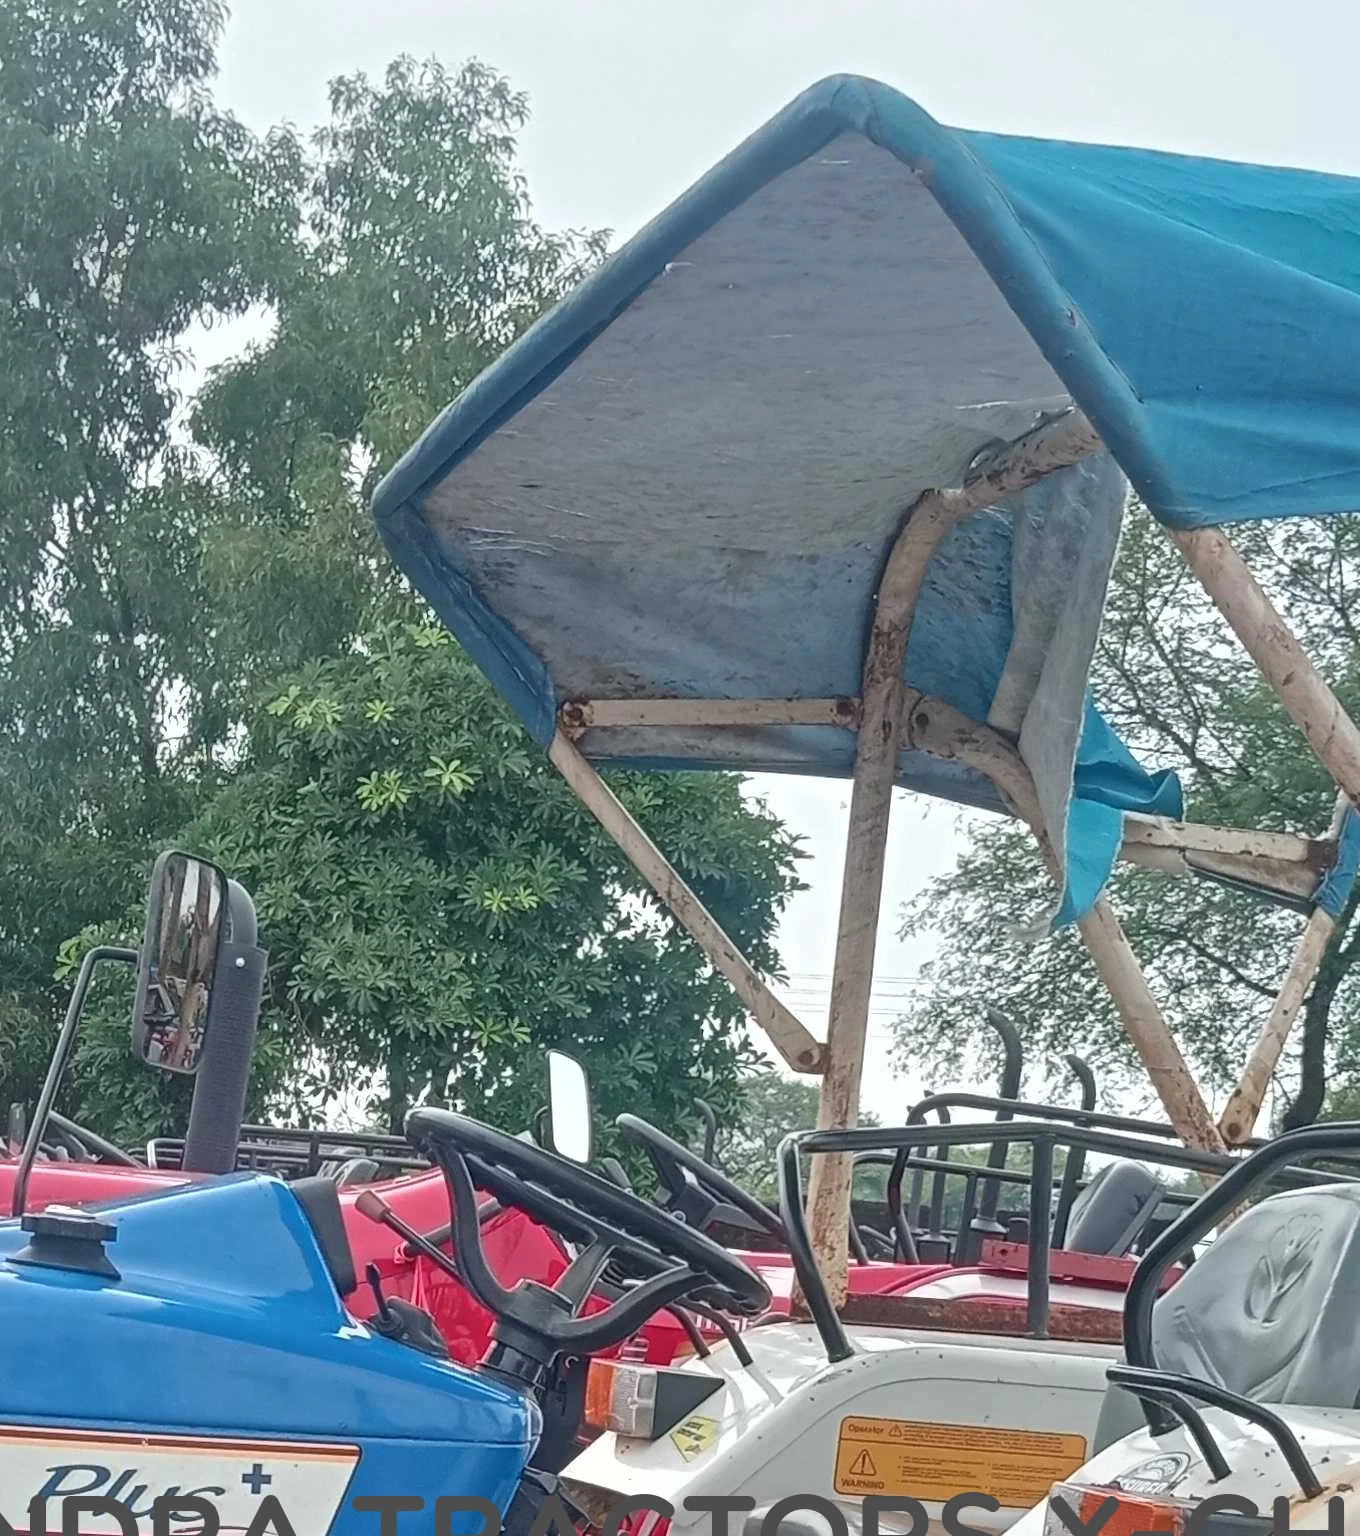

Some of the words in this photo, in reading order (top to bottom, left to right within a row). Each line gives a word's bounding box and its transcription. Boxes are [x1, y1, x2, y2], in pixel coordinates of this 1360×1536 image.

[847, 1423, 885, 1436] Operator
[840, 1476, 886, 1491] WARNING
[26, 1463, 227, 1523] Plus
